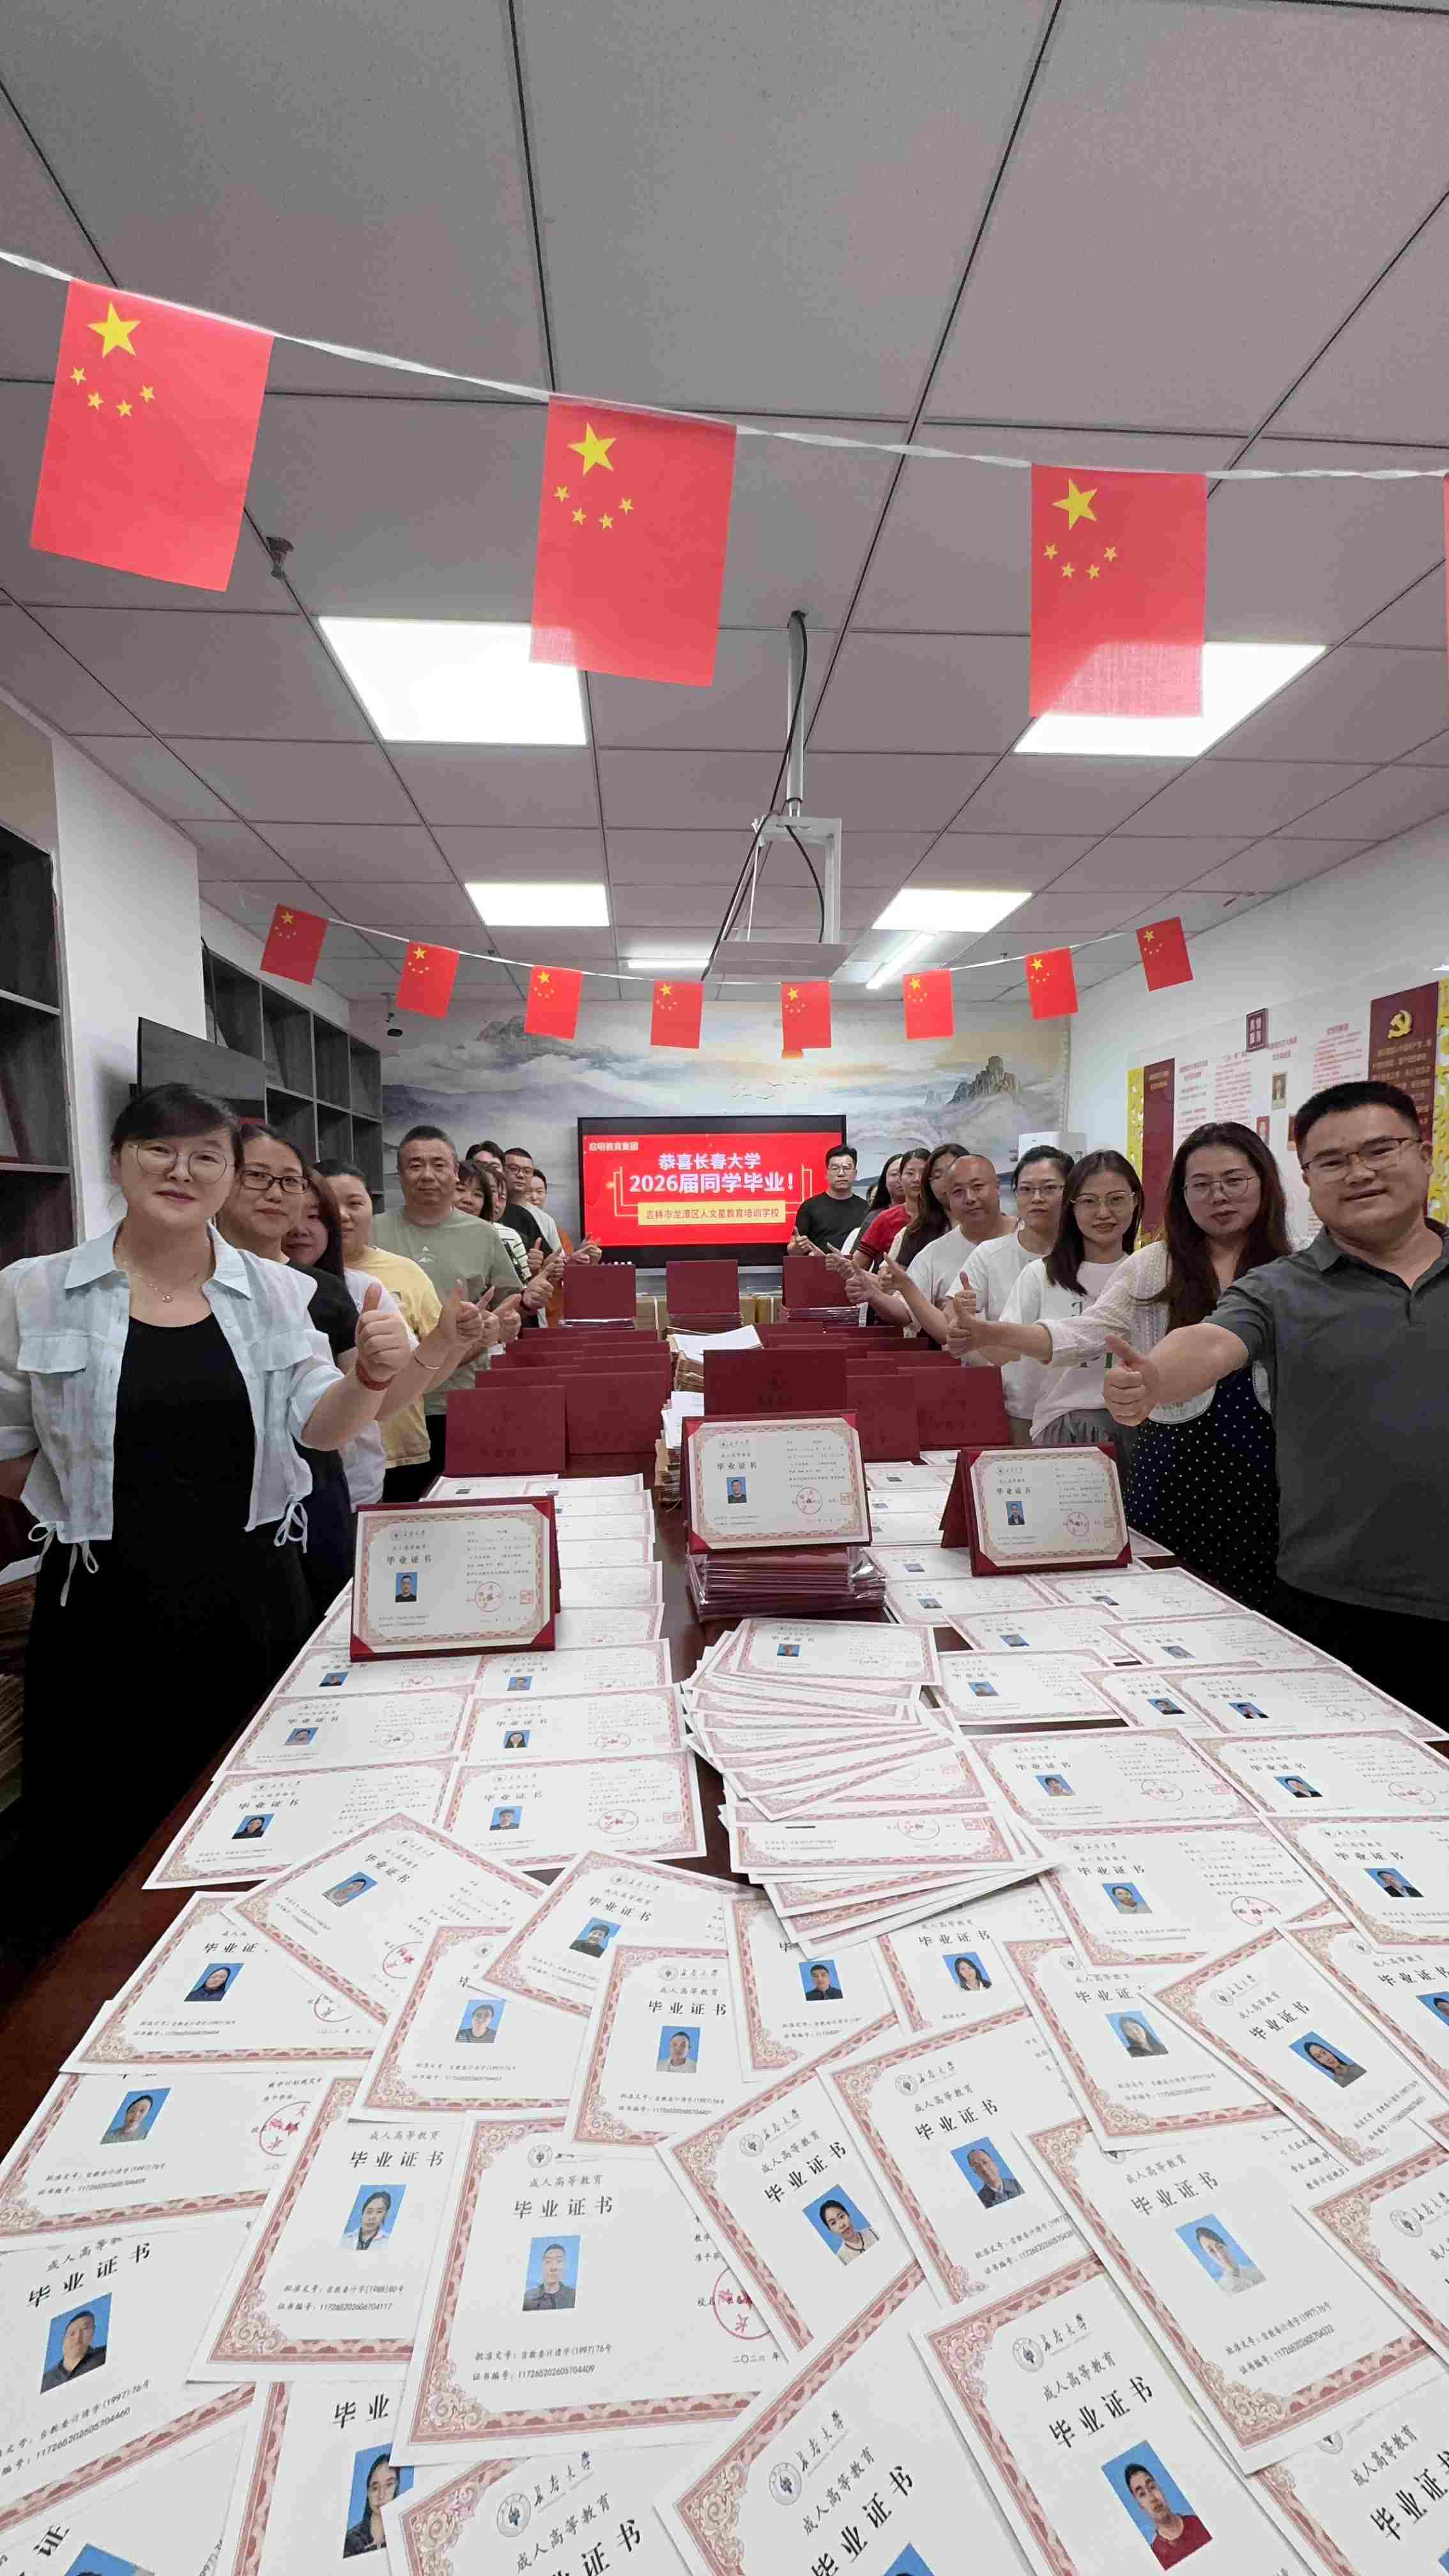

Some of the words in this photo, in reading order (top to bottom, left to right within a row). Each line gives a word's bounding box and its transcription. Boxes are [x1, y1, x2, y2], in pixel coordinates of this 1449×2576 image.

[659, 1153, 762, 1170] 恭喜长春大学
[919, 1930, 992, 1947] 毕业证书
[649, 1998, 726, 2017] 毕业证书
[1247, 2002, 1310, 2039] 毕业证书
[915, 2099, 998, 2140] 毕业证书
[348, 2150, 444, 2169] 毕业证书
[763, 2142, 847, 2203] 毕业证书
[529, 2174, 603, 2188] 成人高等教育
[1130, 2172, 1222, 2214] 毕业证书
[513, 2196, 613, 2220] 毕业证书
[27, 2242, 152, 2308] 毕业证书
[1042, 2351, 1117, 2402] 成人高等教育
[1048, 2376, 1154, 2448] 毕业证书
[1349, 2425, 1418, 2486] 成人高等教育
[803, 2451, 874, 2533] 成人高等教育
[517, 2492, 610, 2572] 成人高等教育
